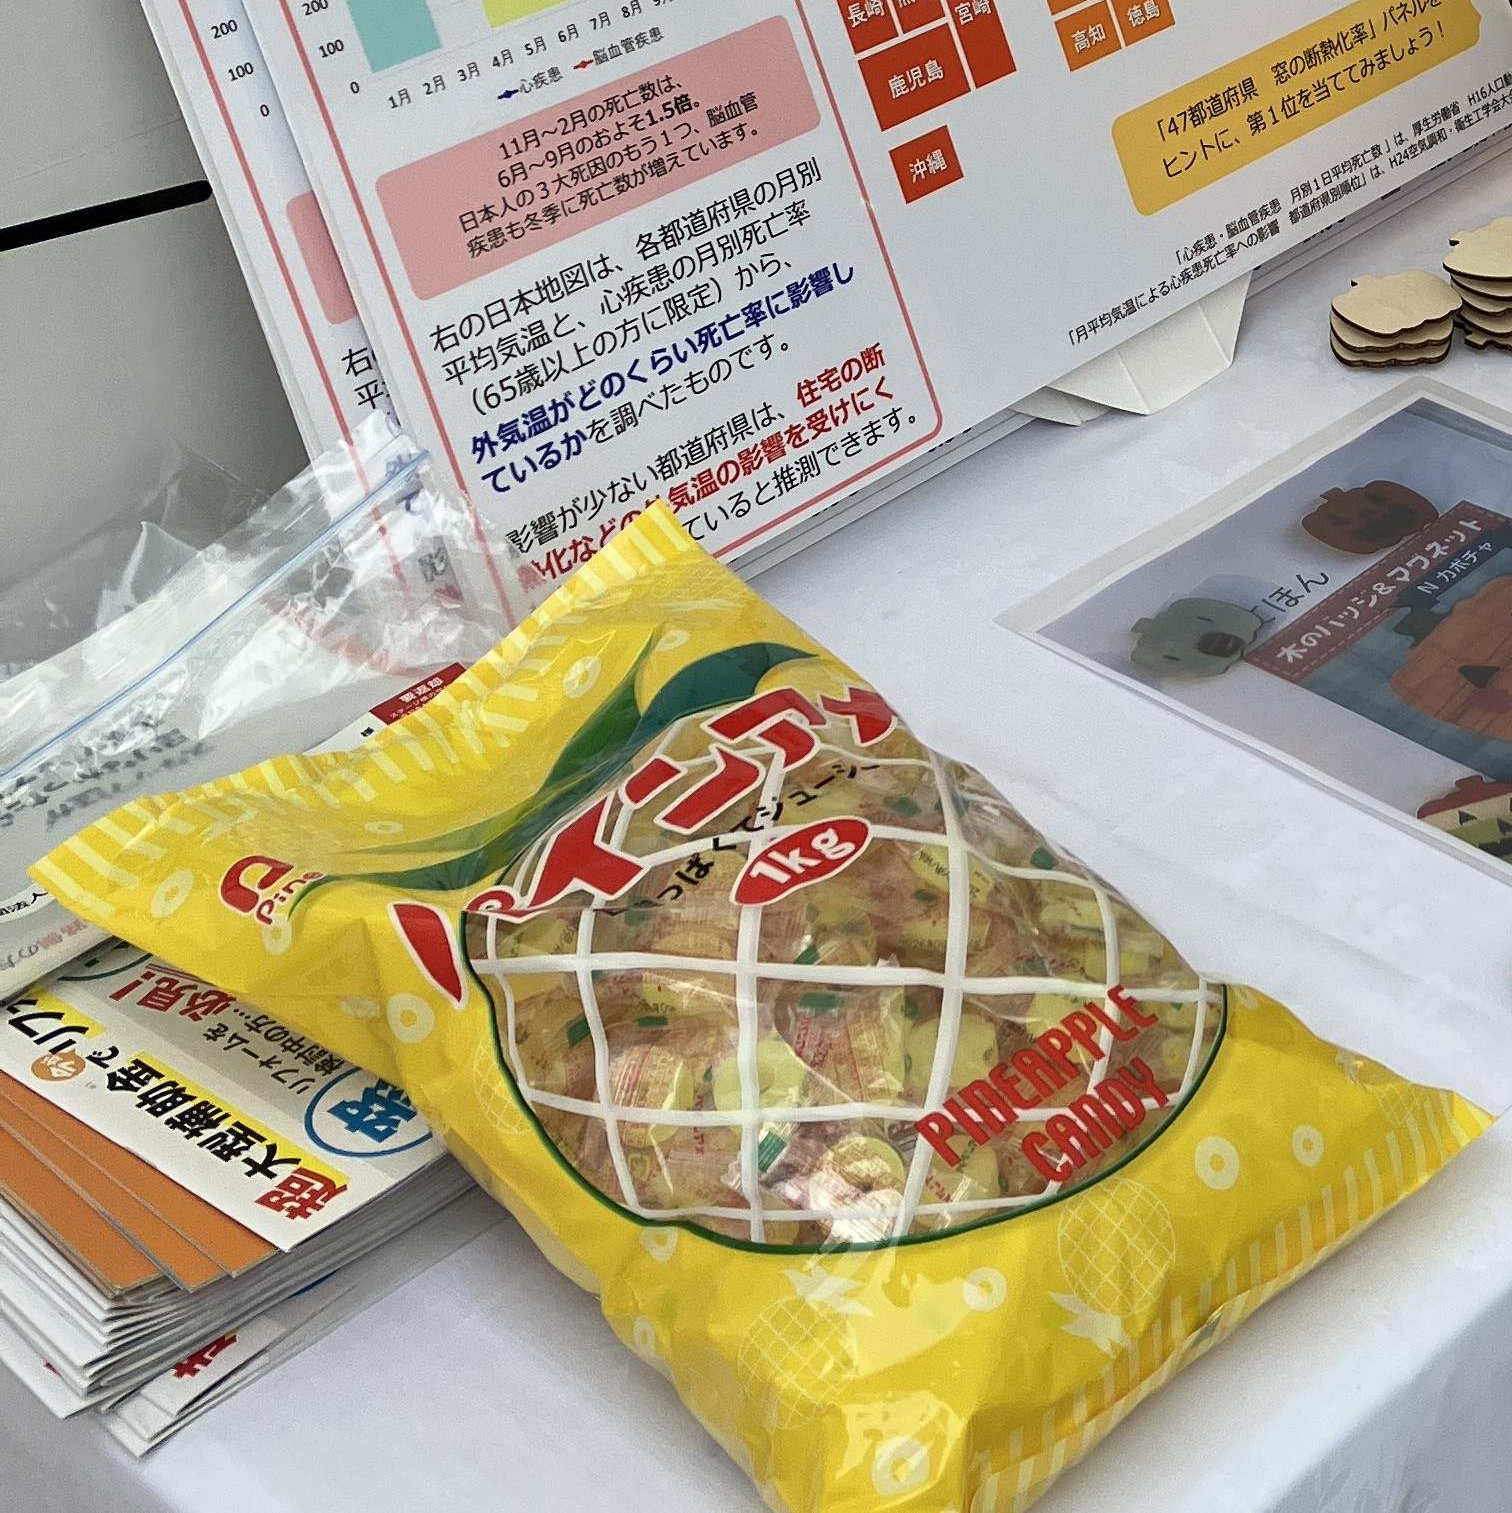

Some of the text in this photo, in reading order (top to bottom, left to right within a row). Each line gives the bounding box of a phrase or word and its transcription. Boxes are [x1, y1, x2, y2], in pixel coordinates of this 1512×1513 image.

[210, 19, 238, 40] 200
[318, 39, 345, 59] 100
[1071, 23, 1107, 55] 高知
[1127, 0, 1161, 28] 徳島
[227, 62, 254, 83] 100
[349, 81, 360, 95] 0
[388, 89, 411, 109] 1月
[422, 75, 447, 95] 2月
[457, 62, 480, 83] 3月
[492, 49, 515, 69] 4月
[524, 36, 548, 57] 5月
[557, 24, 580, 44] 6月
[589, 11, 612, 31] 7月
[621, 0, 643, 19] 8月
[517, 25, 665, 95] 心疾患 脳血管疾患
[887, 59, 944, 100] 鹿児島
[498, 74, 684, 160] 11月〜2月の死亡数は、
[1156, 77, 1259, 143] 「47都道府県
[1161, 20, 1447, 180] ヒントに、第1位を当ててみましょう!
[458, 91, 759, 233] 日本人の3大死因のもう1つ、脳血管
[497, 95, 702, 188] 6月〜9月のおよそ1.5倍。
[909, 149, 949, 184] 沖縄
[467, 127, 760, 259] 疾患も冬季に死亡数が増えています。
[429, 156, 822, 354] 右の日本地図は、各都道府県の月別
[441, 199, 811, 386] 平均気温と、心疾患の月別死亡率
[470, 256, 794, 416] (65歳以上の方に限定)から、
[470, 261, 855, 466] 外気温がどのくらい死亡率に影響し
[481, 340, 790, 494] ているかを調べたものです。
[1436, 541, 1493, 584] カボチャ
[745, 823, 858, 889] 1kg
[203, 1022, 316, 1096] リフォームを
[914, 983, 1160, 1169] PINEAPPLE
[1021, 1056, 1170, 1183] CANDY
